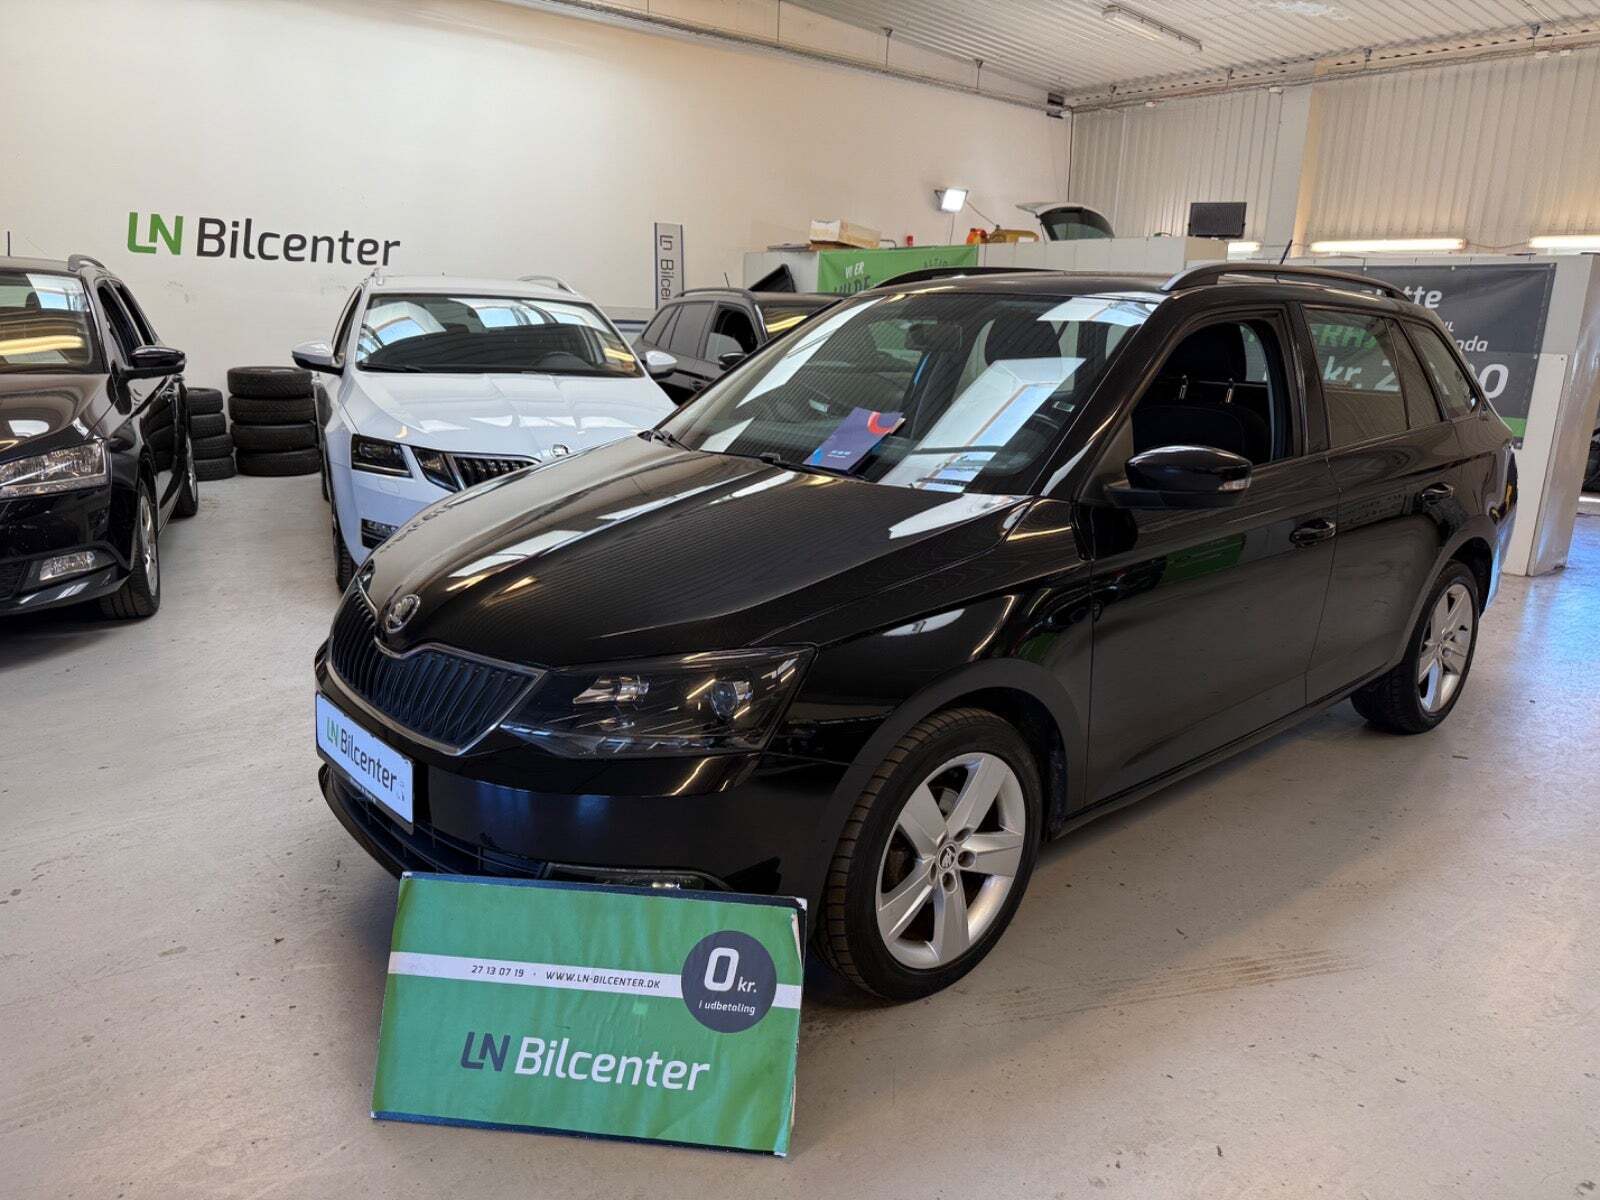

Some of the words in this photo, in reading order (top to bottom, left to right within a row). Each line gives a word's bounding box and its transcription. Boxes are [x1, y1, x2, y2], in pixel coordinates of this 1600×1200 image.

[127, 212, 183, 256] LN
[196, 217, 401, 267] Bilcenter
[1455, 335, 1489, 353] oda
[1323, 355, 1363, 390] kr.
[327, 717, 339, 747] LN
[340, 728, 398, 792] Bilcenter
[471, 965, 483, 975] 27
[486, 966, 496, 976] 13
[499, 968, 511, 977] 07
[514, 969, 525, 978] 19
[545, 971, 661, 989] WWW.LN-BILCENTER.DK
[703, 947, 740, 992] 0
[737, 976, 758, 993] kr.
[705, 1001, 756, 1016] udbetaling
[460, 1031, 511, 1072] LN
[514, 1037, 711, 1091] Bilcenter
